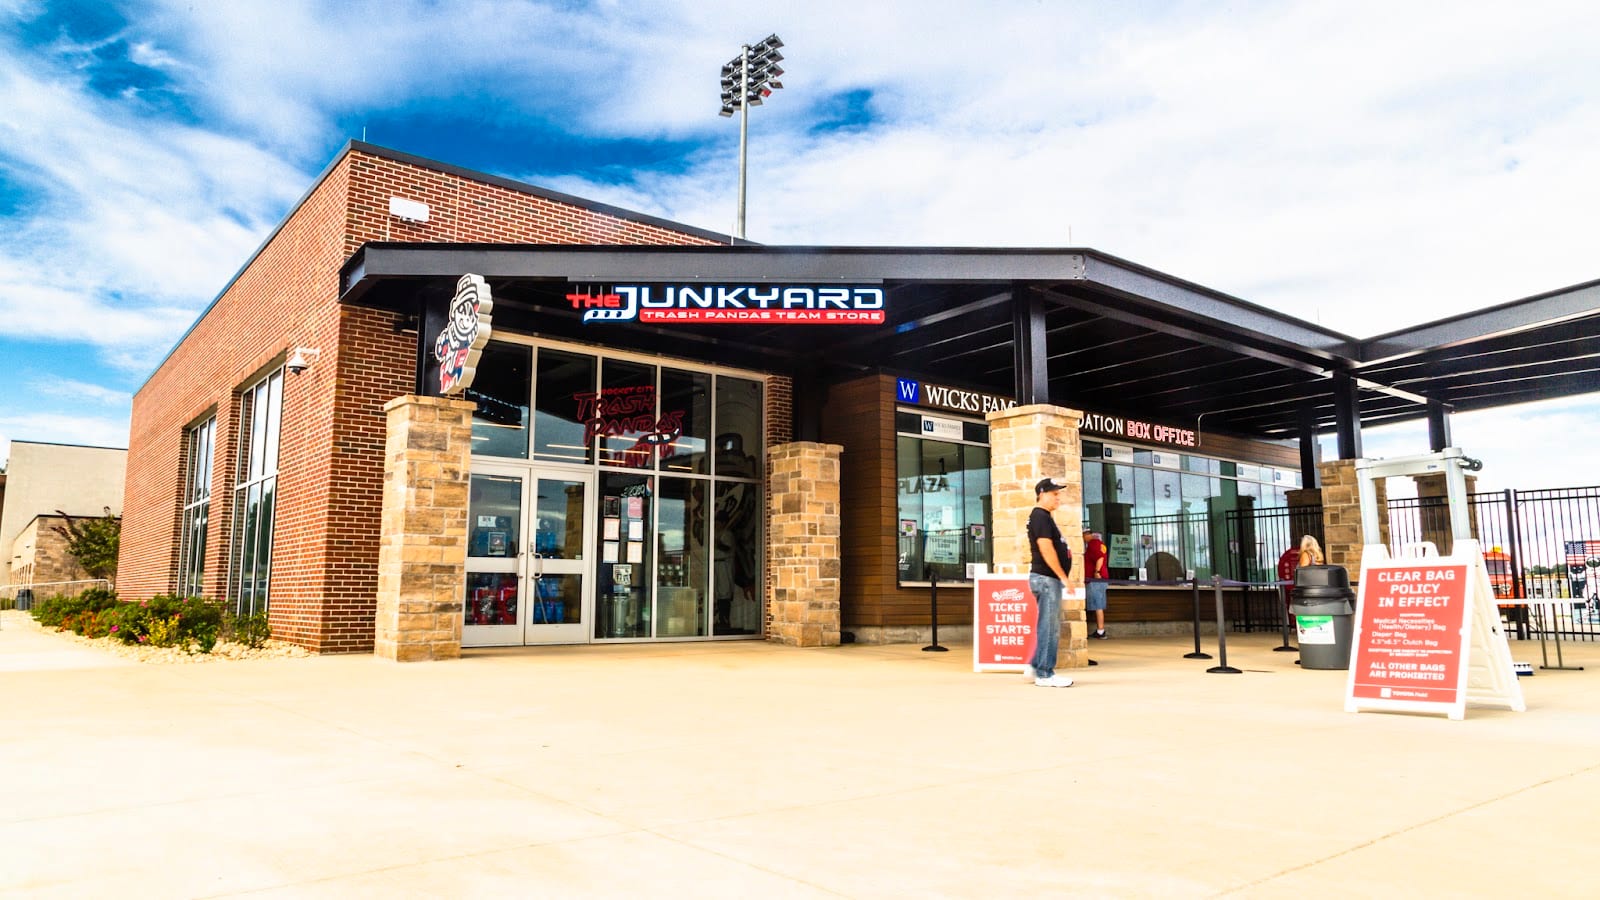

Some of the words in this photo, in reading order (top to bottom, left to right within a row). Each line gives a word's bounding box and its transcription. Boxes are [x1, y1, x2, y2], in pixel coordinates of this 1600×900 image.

[566, 294, 620, 308] THE
[583, 286, 883, 322] JUNKYARD
[644, 311, 699, 320] TRASH
[705, 311, 770, 320] PANDAS
[776, 312, 820, 320] TEAM
[826, 312, 881, 321] STORE
[636, 385, 654, 394] CITY
[899, 380, 917, 400] W
[573, 392, 656, 421] TRASH
[924, 384, 980, 413] WICKS
[1126, 420, 1151, 440] BOX
[1153, 424, 1195, 447] OFFICE
[583, 410, 686, 447] PANDAS
[898, 477, 950, 495] PLAZA
[1115, 478, 1123, 494] 4
[1164, 484, 1171, 498] 5
[1378, 571, 1421, 582] CLEAR
[1426, 569, 1455, 581] BAG
[1390, 583, 1440, 594] POLICY
[988, 603, 1028, 612] TICKET
[1378, 597, 1394, 607] IN
[1398, 596, 1450, 607] EFFECT
[995, 614, 1022, 623] LINE
[986, 625, 1031, 634] STARTS
[993, 636, 1024, 646] HERE
[1370, 662, 1386, 670] ALL
[1388, 662, 1417, 670] OTHER
[1420, 663, 1446, 671] BAGS
[1369, 670, 1386, 678] ARE
[1389, 671, 1445, 681] PROHIBITED
